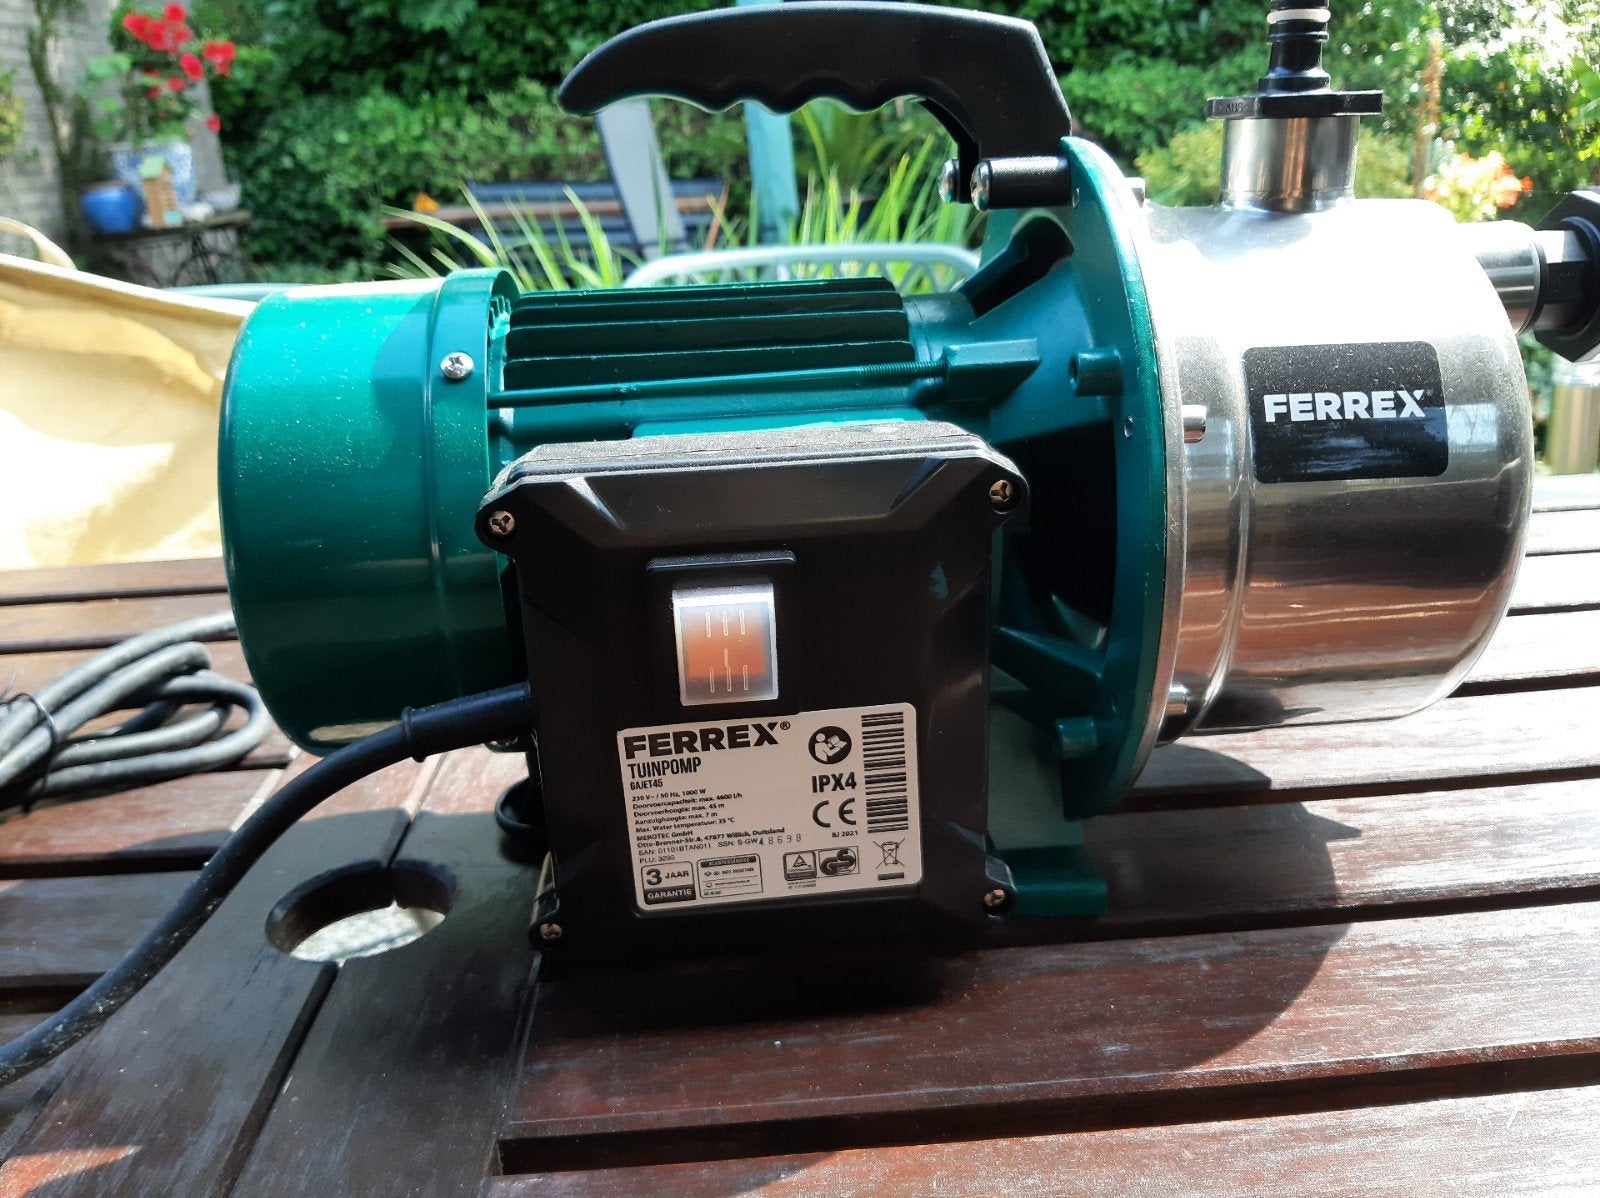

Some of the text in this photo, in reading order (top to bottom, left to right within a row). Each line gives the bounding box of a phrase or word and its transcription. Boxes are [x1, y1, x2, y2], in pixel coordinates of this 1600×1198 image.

[627, 757, 701, 779] TUINPOMP
[630, 779, 663, 791] GAJET45
[811, 771, 857, 793] IPX4
[634, 806, 691, 818] Doorvoerhoogte:
[636, 830, 693, 841] MEROTEC GmbH
[704, 833, 724, 841] 47877
[752, 827, 785, 836] Duitsland
[646, 868, 689, 885] 3 JAAR
[647, 888, 692, 899] GARANTIE
